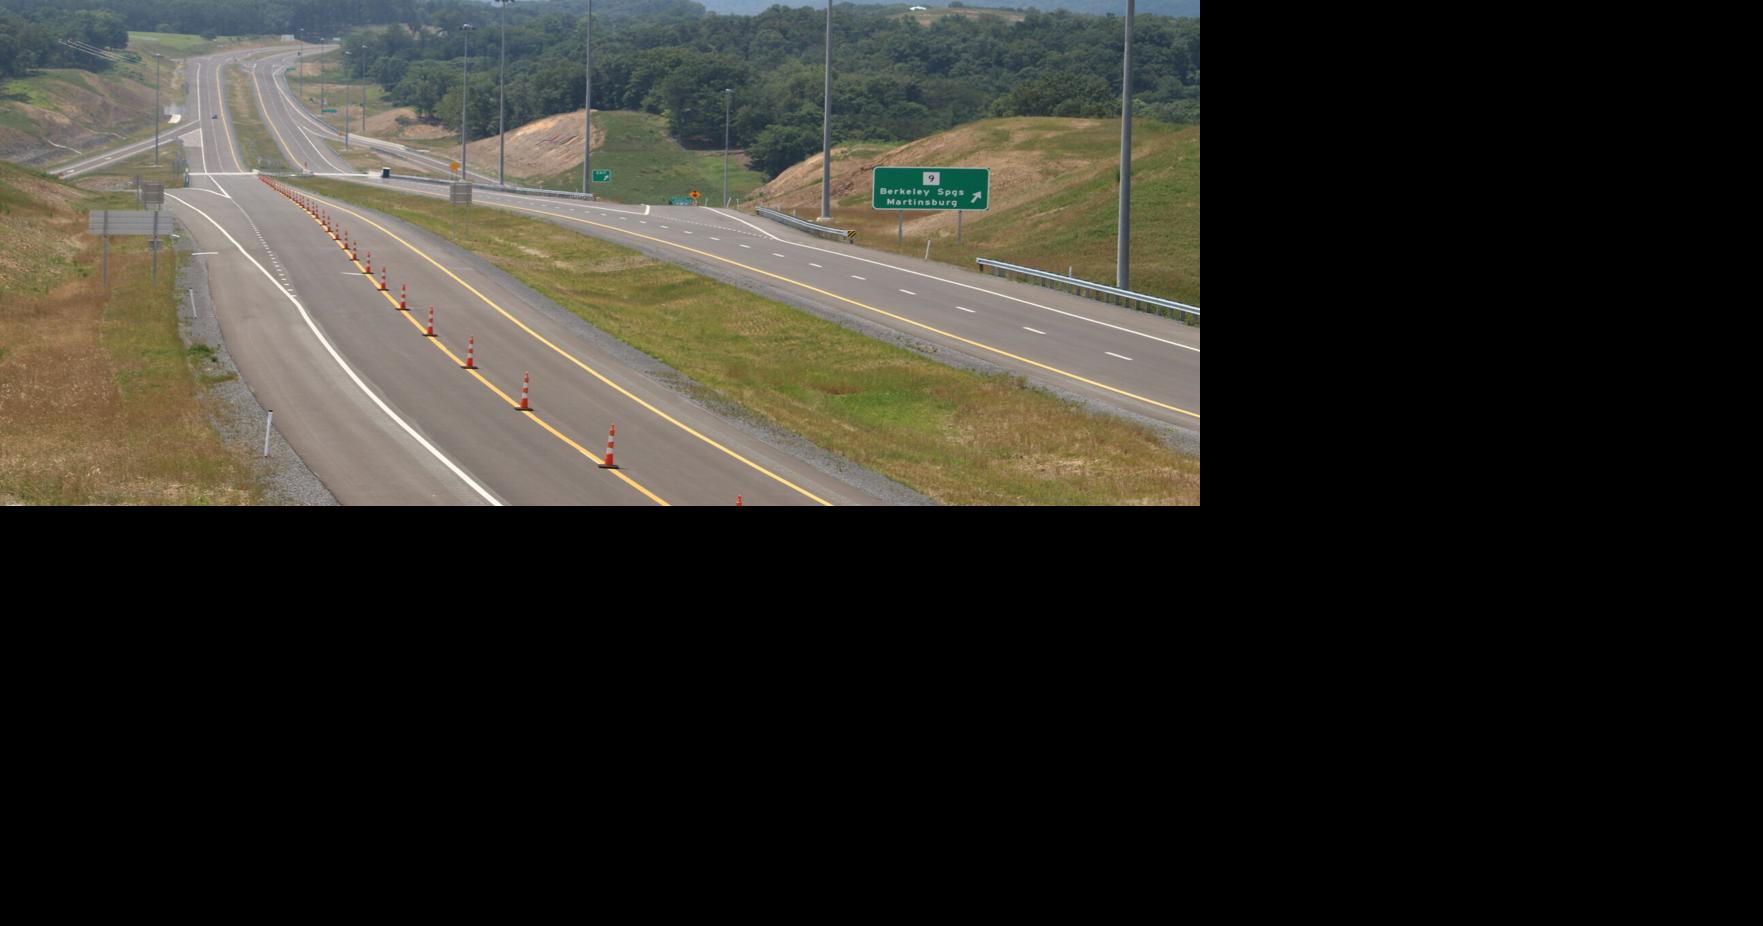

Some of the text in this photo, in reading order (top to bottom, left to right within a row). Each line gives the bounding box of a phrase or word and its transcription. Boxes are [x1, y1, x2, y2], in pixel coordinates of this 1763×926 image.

[880, 187, 965, 197] Berkeley Spgs
[886, 198, 958, 207] Martinsburg
